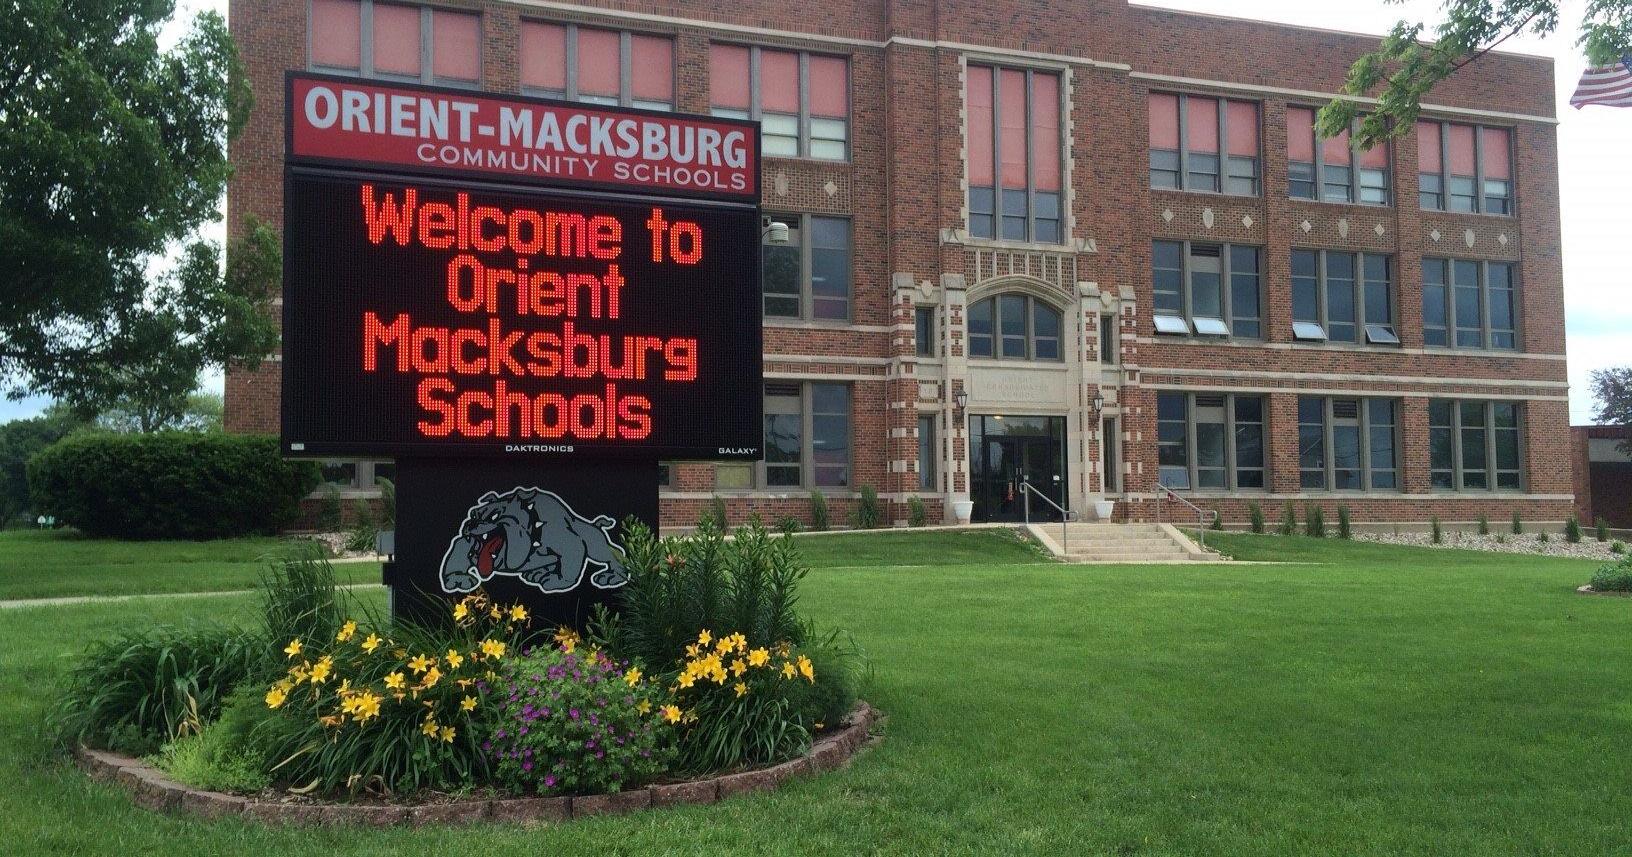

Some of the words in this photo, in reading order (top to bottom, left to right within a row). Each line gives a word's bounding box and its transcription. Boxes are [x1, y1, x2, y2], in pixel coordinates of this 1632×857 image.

[304, 86, 747, 168] ORIENT-MACKSBURG
[417, 143, 598, 177] COMMUNITY
[614, 162, 746, 190] SCHOOLS
[362, 185, 622, 260] Welcome
[647, 208, 702, 265] to
[447, 254, 625, 319] Orient
[364, 312, 697, 381] Macksburg
[417, 378, 651, 439] Schools
